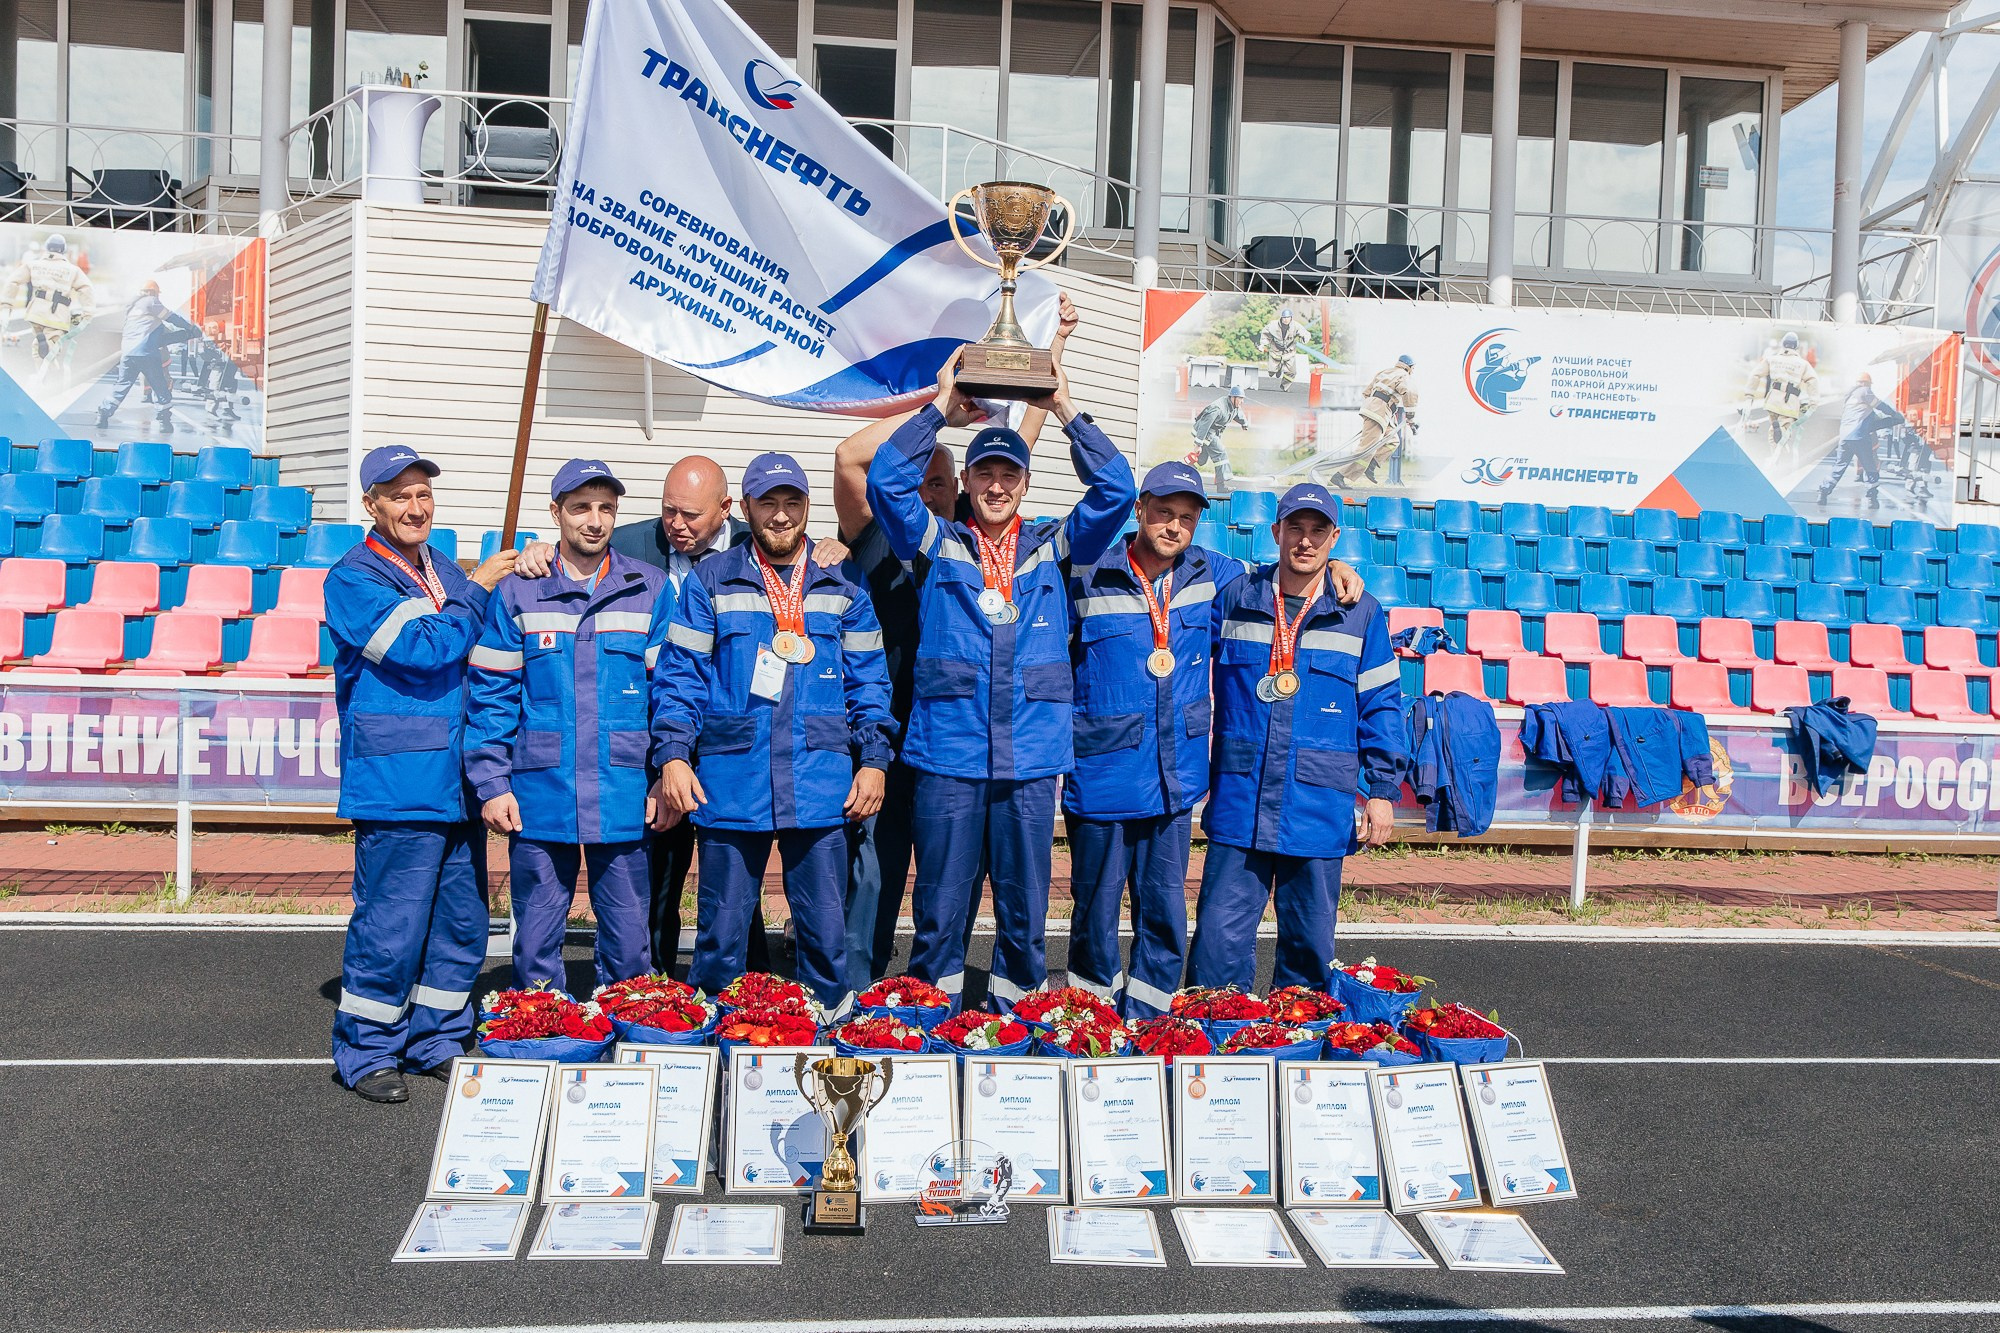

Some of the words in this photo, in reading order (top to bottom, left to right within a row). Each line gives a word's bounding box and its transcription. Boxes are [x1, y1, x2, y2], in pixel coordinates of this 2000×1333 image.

[641, 47, 872, 217] ТРАНСНЕФТЬ
[639, 189, 790, 285] СОРЕВНОВАНИЯ
[571, 179, 596, 206] НА
[599, 196, 678, 248] ЗВАНИЕ
[678, 243, 768, 299] «ЛУЧШИЙ
[768, 289, 837, 338] РАСЧЕТ
[567, 205, 717, 298] ДОБРОВОЛЬНОЙ
[718, 288, 826, 359] ПОЖАРНОЙ
[628, 269, 737, 334] ДРУЖИНЫ»
[1551, 355, 1593, 366] ЛУЧШИЙ
[1551, 367, 1629, 379] ДОБРОВОЛЬНОЙ
[1551, 379, 1605, 390] ПОЖАРНОЙ
[1607, 381, 1658, 392] ДРУЖИНЫ
[1550, 390, 1570, 400] ПАО
[1572, 391, 1641, 403] «ТРАНСНЕФТЬ»
[1567, 407, 1657, 422] ТРАНСНЕФТЬ
[1513, 457, 1529, 465] ЛЕТ
[1517, 466, 1639, 485] ТРАНСНЕФТЬ
[783, 641, 788, 649] 1
[1284, 680, 1289, 688] 1
[1683, 806, 1710, 816] ВДПО
[659, 1085, 678, 1093] ЛОМ
[765, 1089, 798, 1097] ДИПЛОМ
[481, 1098, 514, 1106] ДИПЛОМ
[891, 1096, 923, 1104] ДИПЛОМ
[999, 1096, 1032, 1104] ДИПЛОМ
[1103, 1099, 1134, 1107] ДИПЛОМ
[1209, 1098, 1241, 1106] ДИПЛОМ
[588, 1102, 621, 1110] ДИПЛОМ
[1316, 1103, 1347, 1111] ДИПЛОМ
[1500, 1101, 1527, 1110] ДИПЛОМ
[928, 1189, 961, 1197] ТУШИЛА
